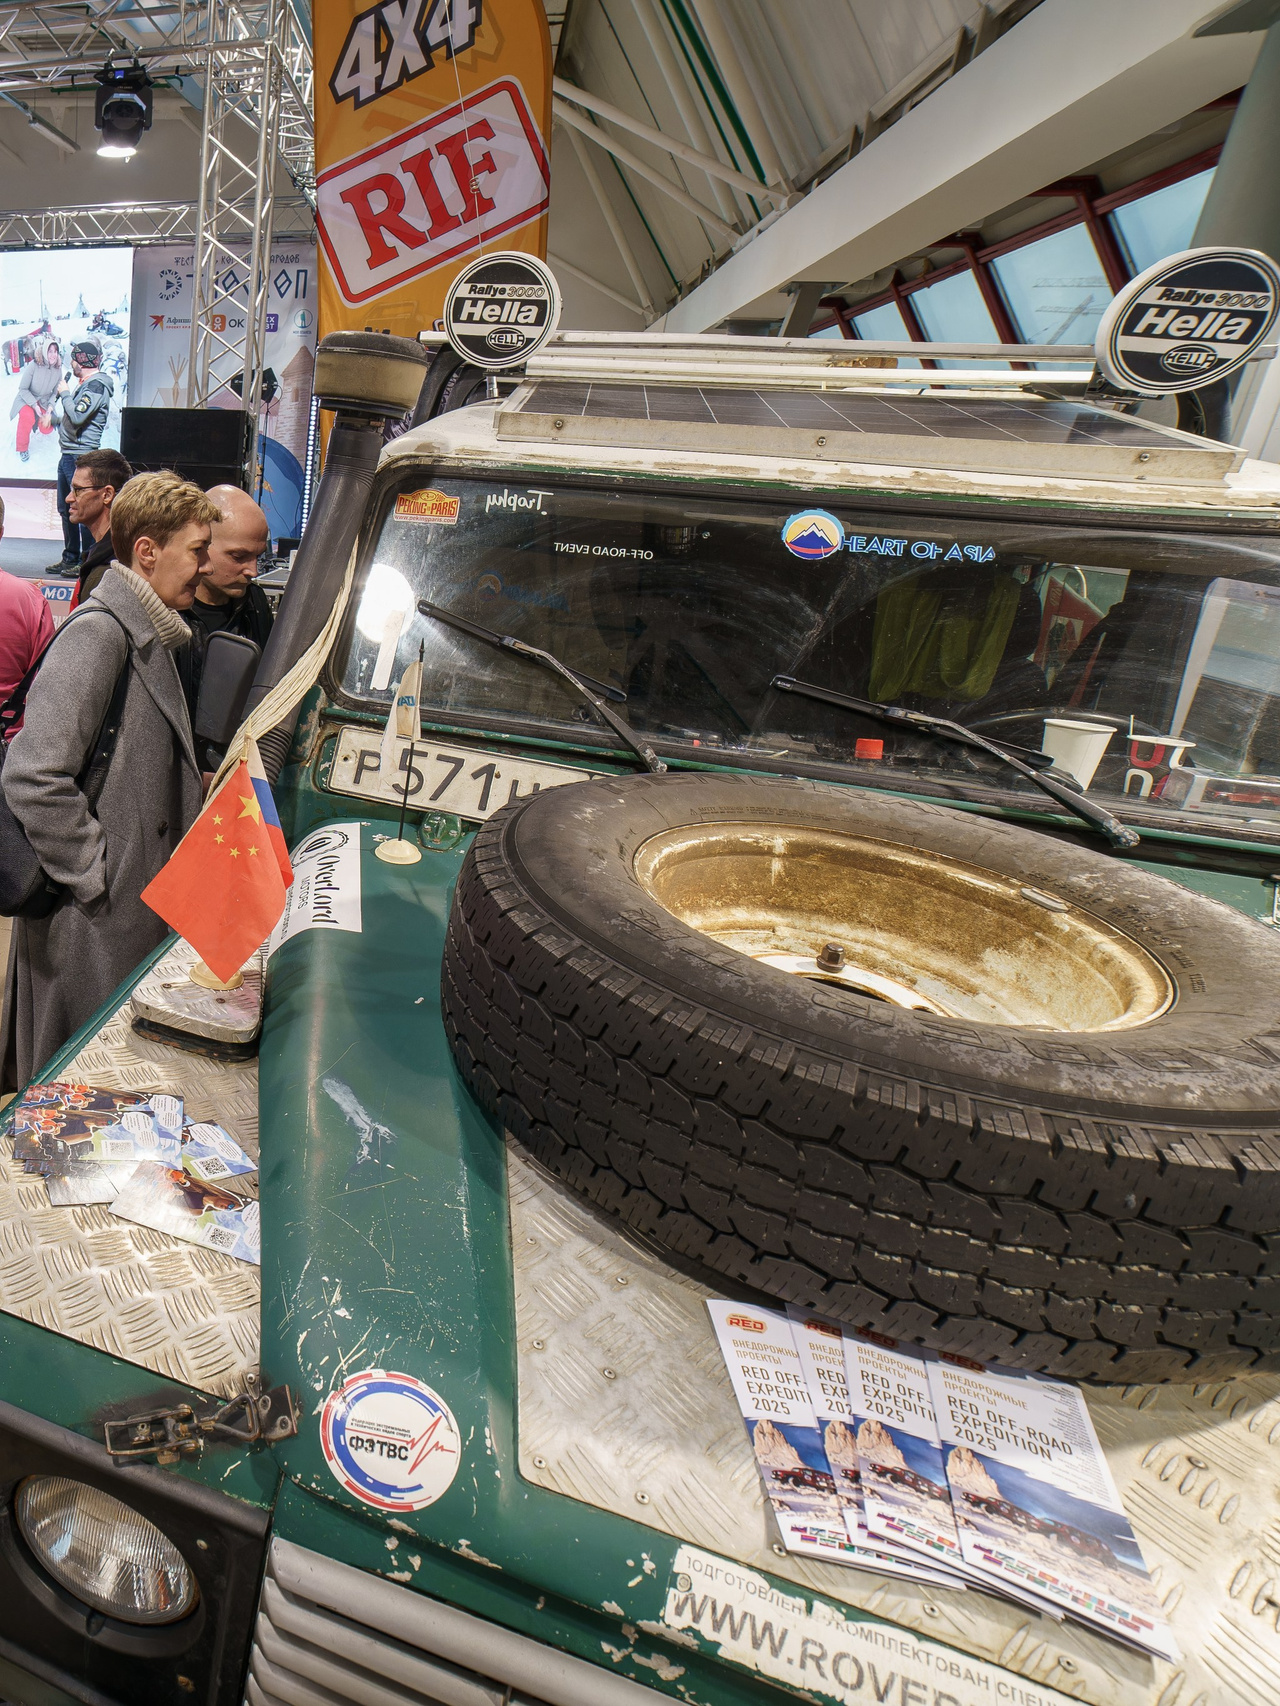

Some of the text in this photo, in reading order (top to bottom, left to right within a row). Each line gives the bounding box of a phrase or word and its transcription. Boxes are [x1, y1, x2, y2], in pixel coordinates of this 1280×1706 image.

[340, 118, 497, 270] RIF
[468, 284, 545, 298] Rallye 3000
[1157, 288, 1270, 309] Rallye 3000
[460, 300, 538, 324] Hella
[1132, 307, 1252, 340] Hella
[490, 334, 525, 346] HELLA
[1165, 351, 1218, 369] HELLA
[398, 496, 428, 514] PEKING
[430, 500, 457, 516] PARIS
[839, 535, 907, 557] HEART
[297, 875, 311, 910] MOTORS
[730, 1317, 764, 1330] RED
[732, 1339, 799, 1359] ВНЕДОРОЖНЫ
[736, 1350, 783, 1365] ПРОЕКТЫ
[812, 1352, 846, 1368] ПРОЕК
[857, 1346, 929, 1380] ВНЕДОРОЖНЫ
[858, 1355, 907, 1380] ПРОЕКТЫ
[741, 1365, 807, 1387] RED OFF-
[816, 1367, 846, 1385] RED
[861, 1369, 933, 1405] RED OFF-
[746, 1381, 813, 1405] EXPEDITI
[942, 1370, 1029, 1411] ВНЕДОРОЖНЫЕ
[944, 1381, 997, 1407] ПРОЕКТЫ
[752, 1397, 791, 1415] 2025
[825, 1398, 853, 1416] 202
[862, 1384, 937, 1423] EXPEDITI
[865, 1399, 905, 1423] 2025
[947, 1395, 1073, 1456] RED OFF-ROAD
[950, 1410, 1053, 1461] EXPEDITION
[953, 1425, 997, 1452] 2025
